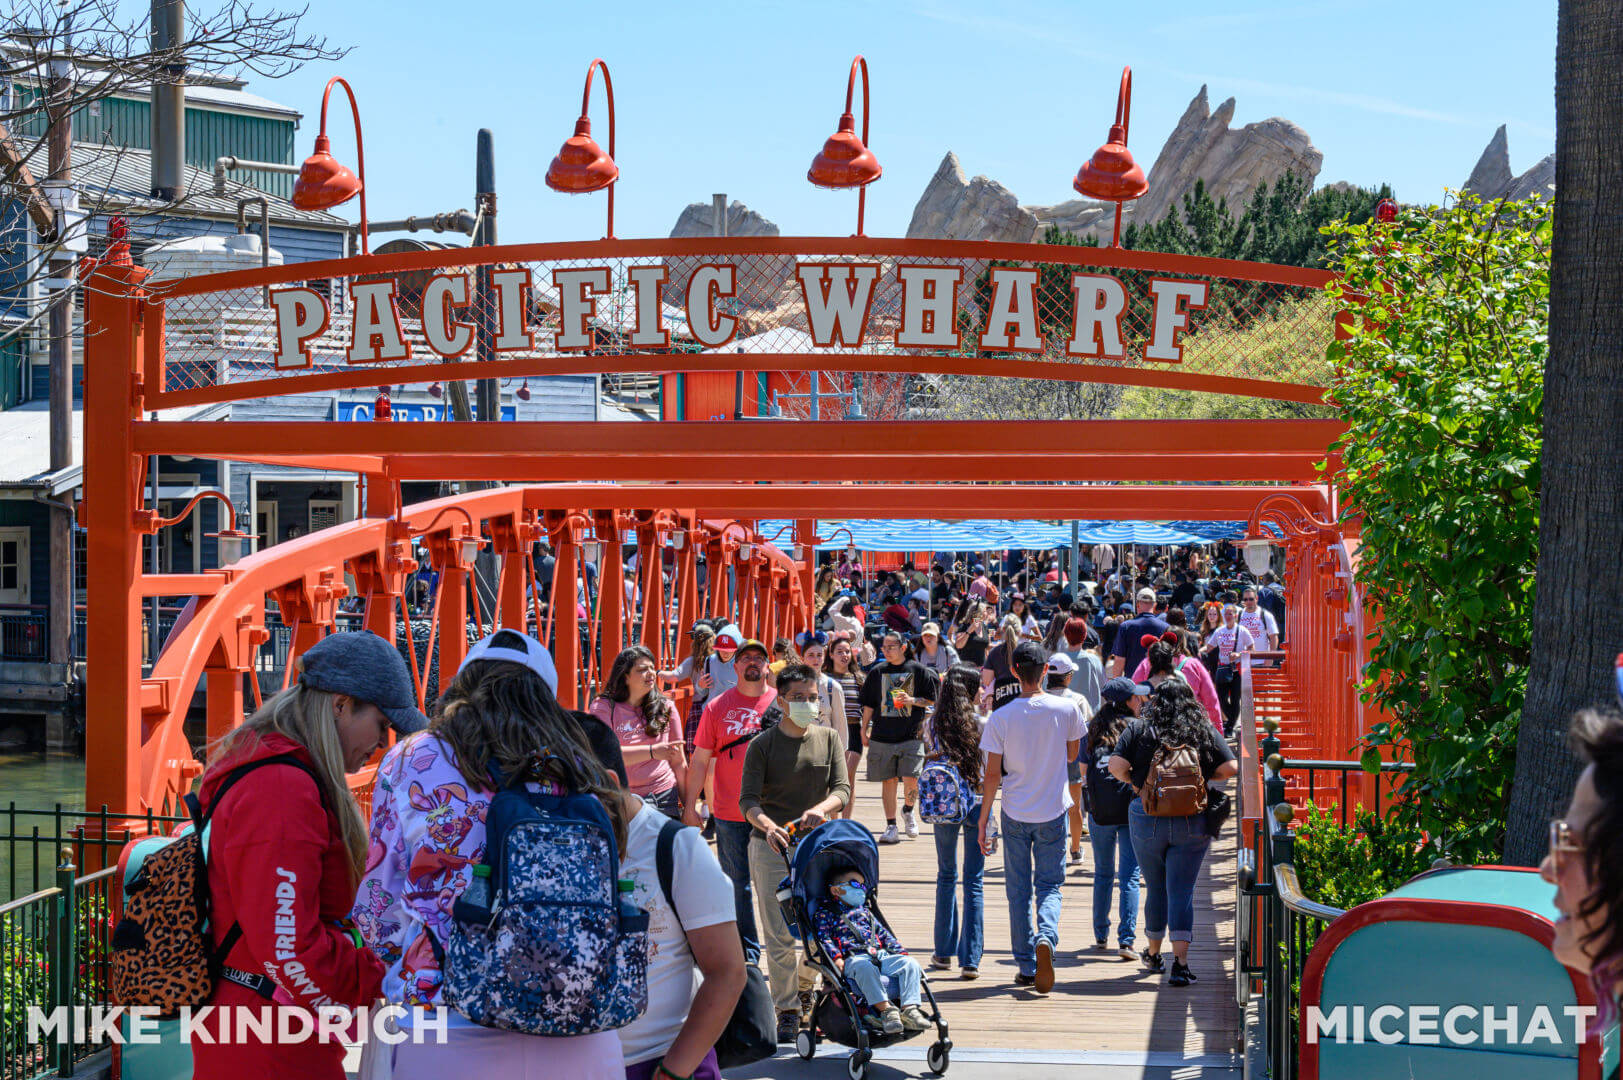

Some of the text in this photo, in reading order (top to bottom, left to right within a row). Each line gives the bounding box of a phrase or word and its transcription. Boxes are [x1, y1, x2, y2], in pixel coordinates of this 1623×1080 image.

[269, 262, 1210, 371] PACIFIC WHARF
[230, 967, 254, 985] LOVE
[274, 866, 321, 996] AND FRIENDS
